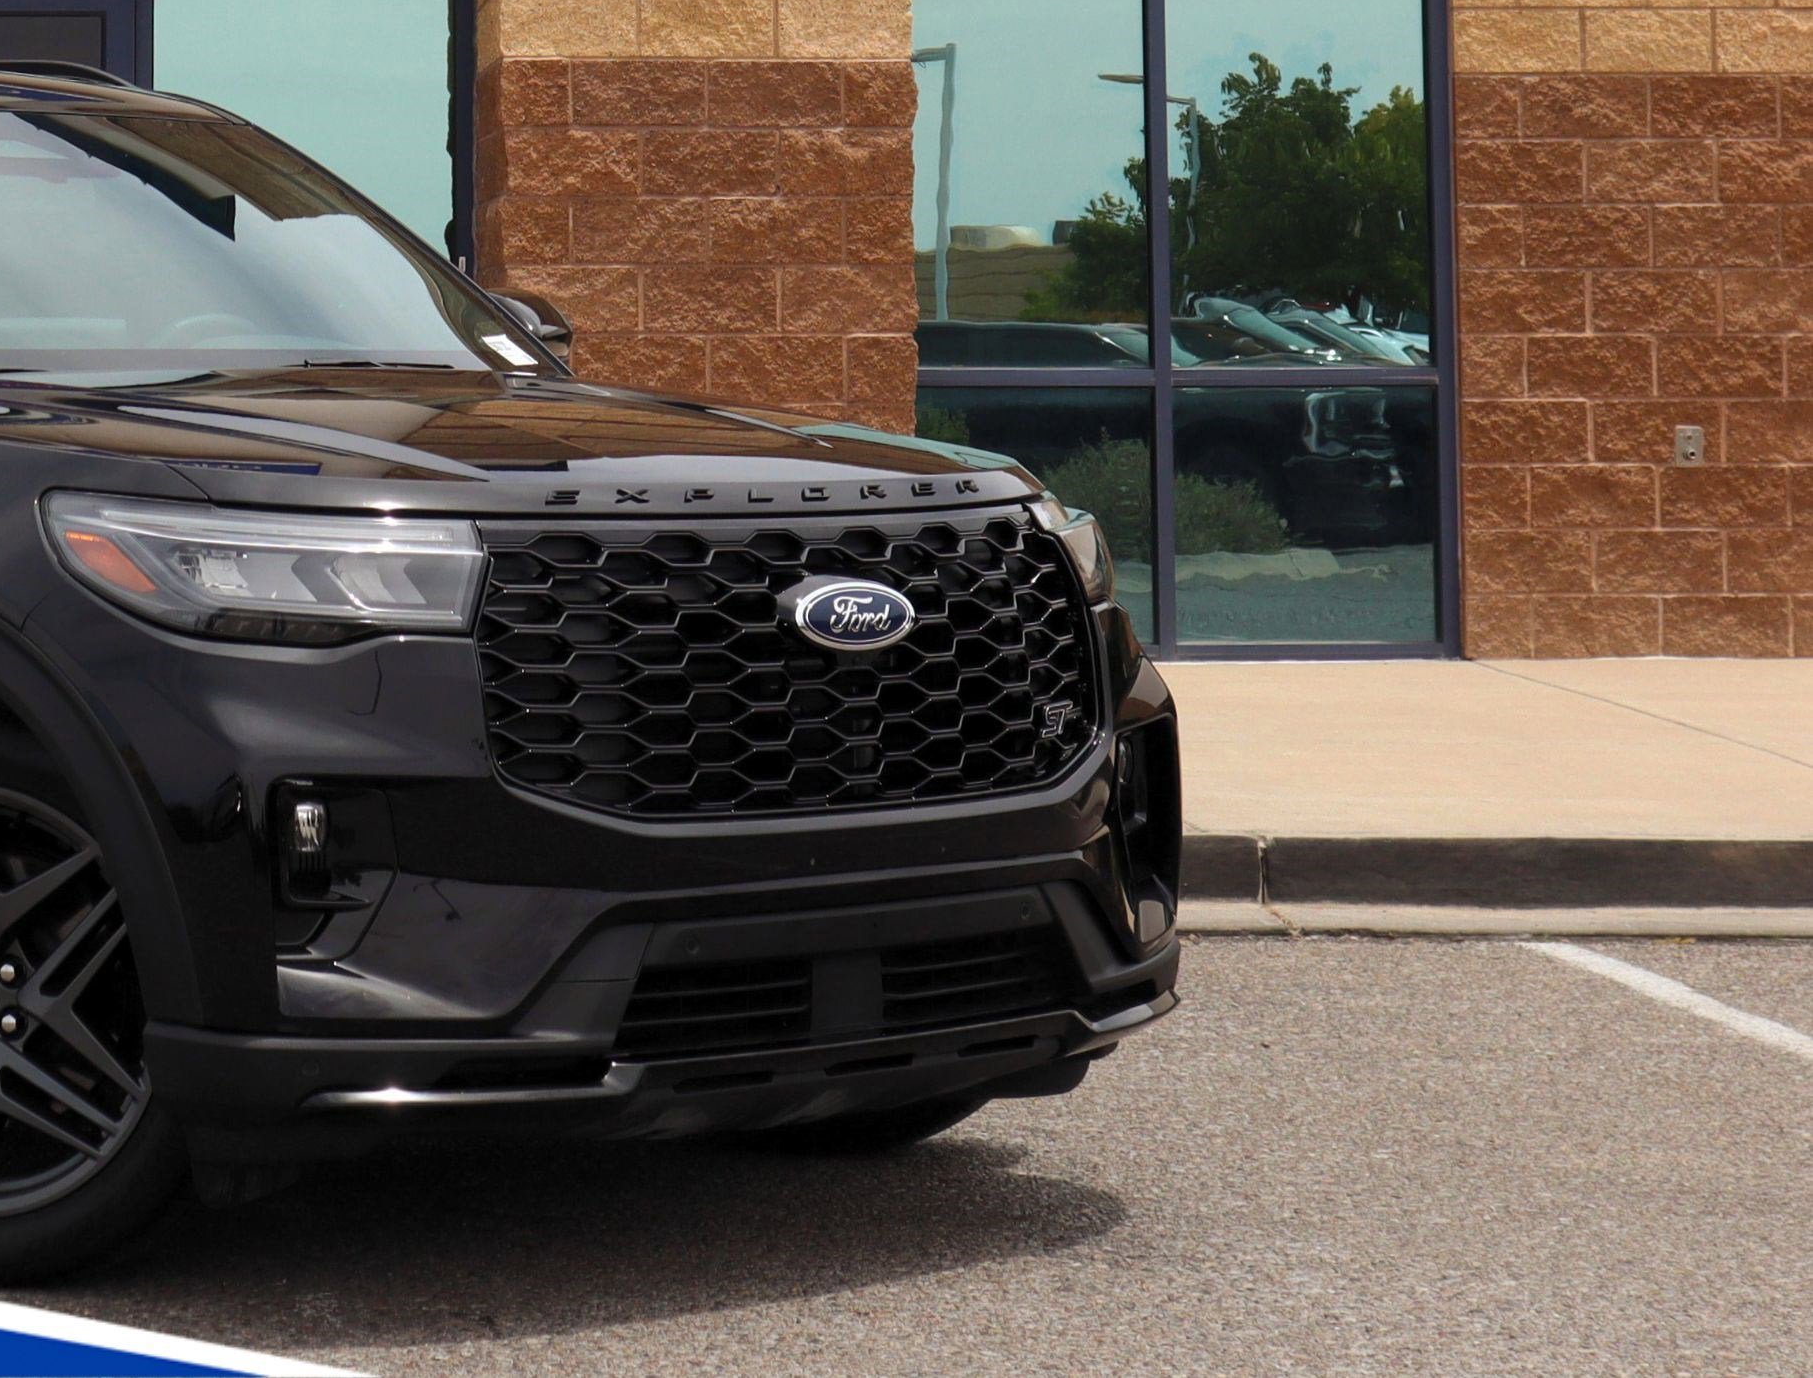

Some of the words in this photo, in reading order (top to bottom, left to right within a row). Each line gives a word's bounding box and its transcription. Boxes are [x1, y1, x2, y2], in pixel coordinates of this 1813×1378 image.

[544, 477, 981, 506] EXPLORER
[829, 595, 892, 634] Ford
[1041, 700, 1074, 738] ST
